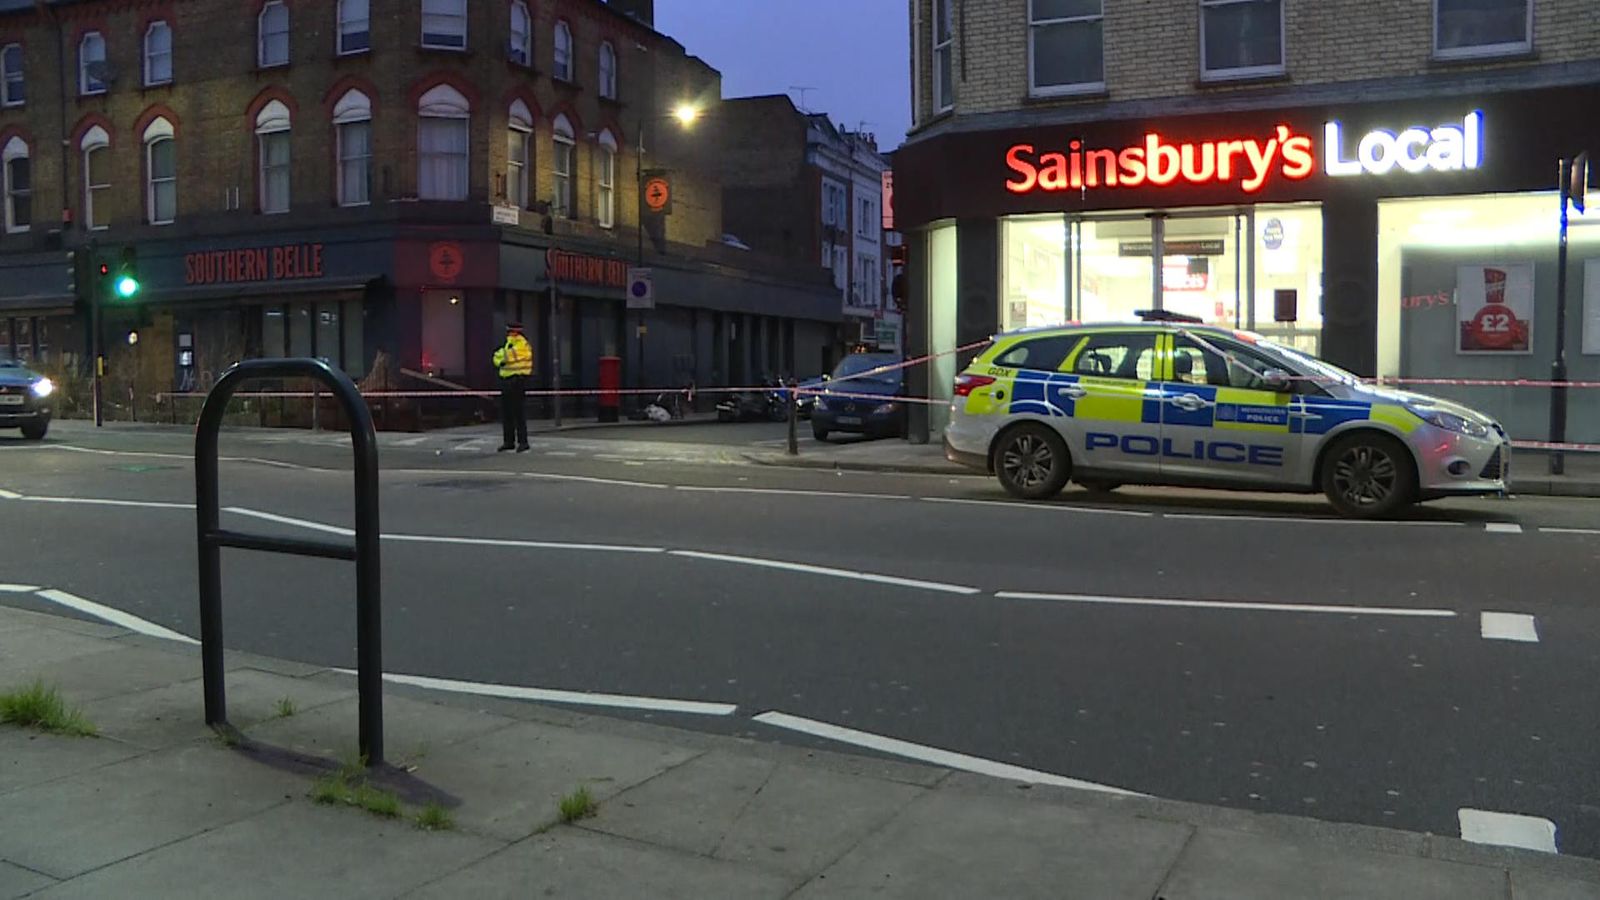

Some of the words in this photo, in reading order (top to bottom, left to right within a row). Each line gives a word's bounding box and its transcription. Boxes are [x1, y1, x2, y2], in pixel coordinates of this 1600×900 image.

[1006, 125, 1313, 192] Sainsbury's
[1325, 109, 1484, 176] Local
[185, 247, 268, 285] SOUTHERN
[272, 244, 323, 280] BELLE
[1481, 314, 1509, 331] £2
[1247, 414, 1280, 423] POLICE
[1086, 432, 1284, 467] POLICE
